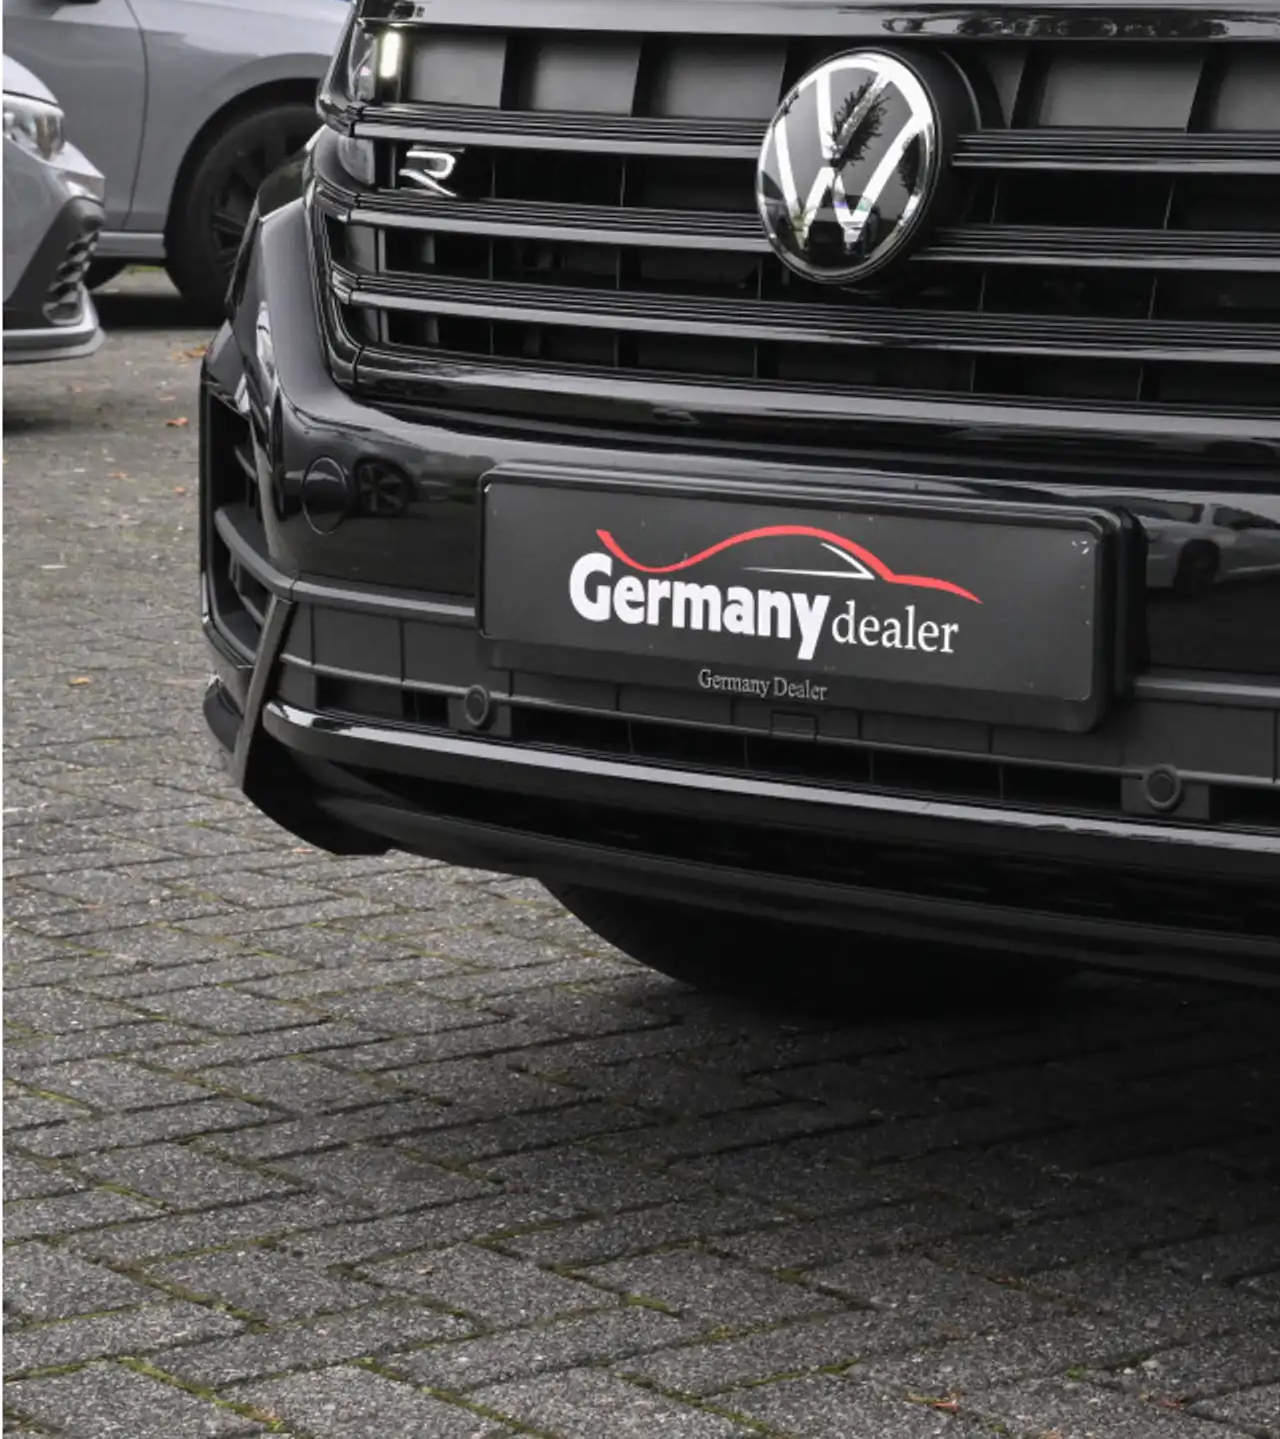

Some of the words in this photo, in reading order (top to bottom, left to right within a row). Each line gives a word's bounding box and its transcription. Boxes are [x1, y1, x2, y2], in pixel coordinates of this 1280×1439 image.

[398, 150, 457, 198] R
[764, 50, 936, 271] VW
[568, 551, 831, 660] Germany
[831, 598, 960, 654] dealer
[697, 667, 770, 698] Germany
[773, 675, 829, 701] Dealer
